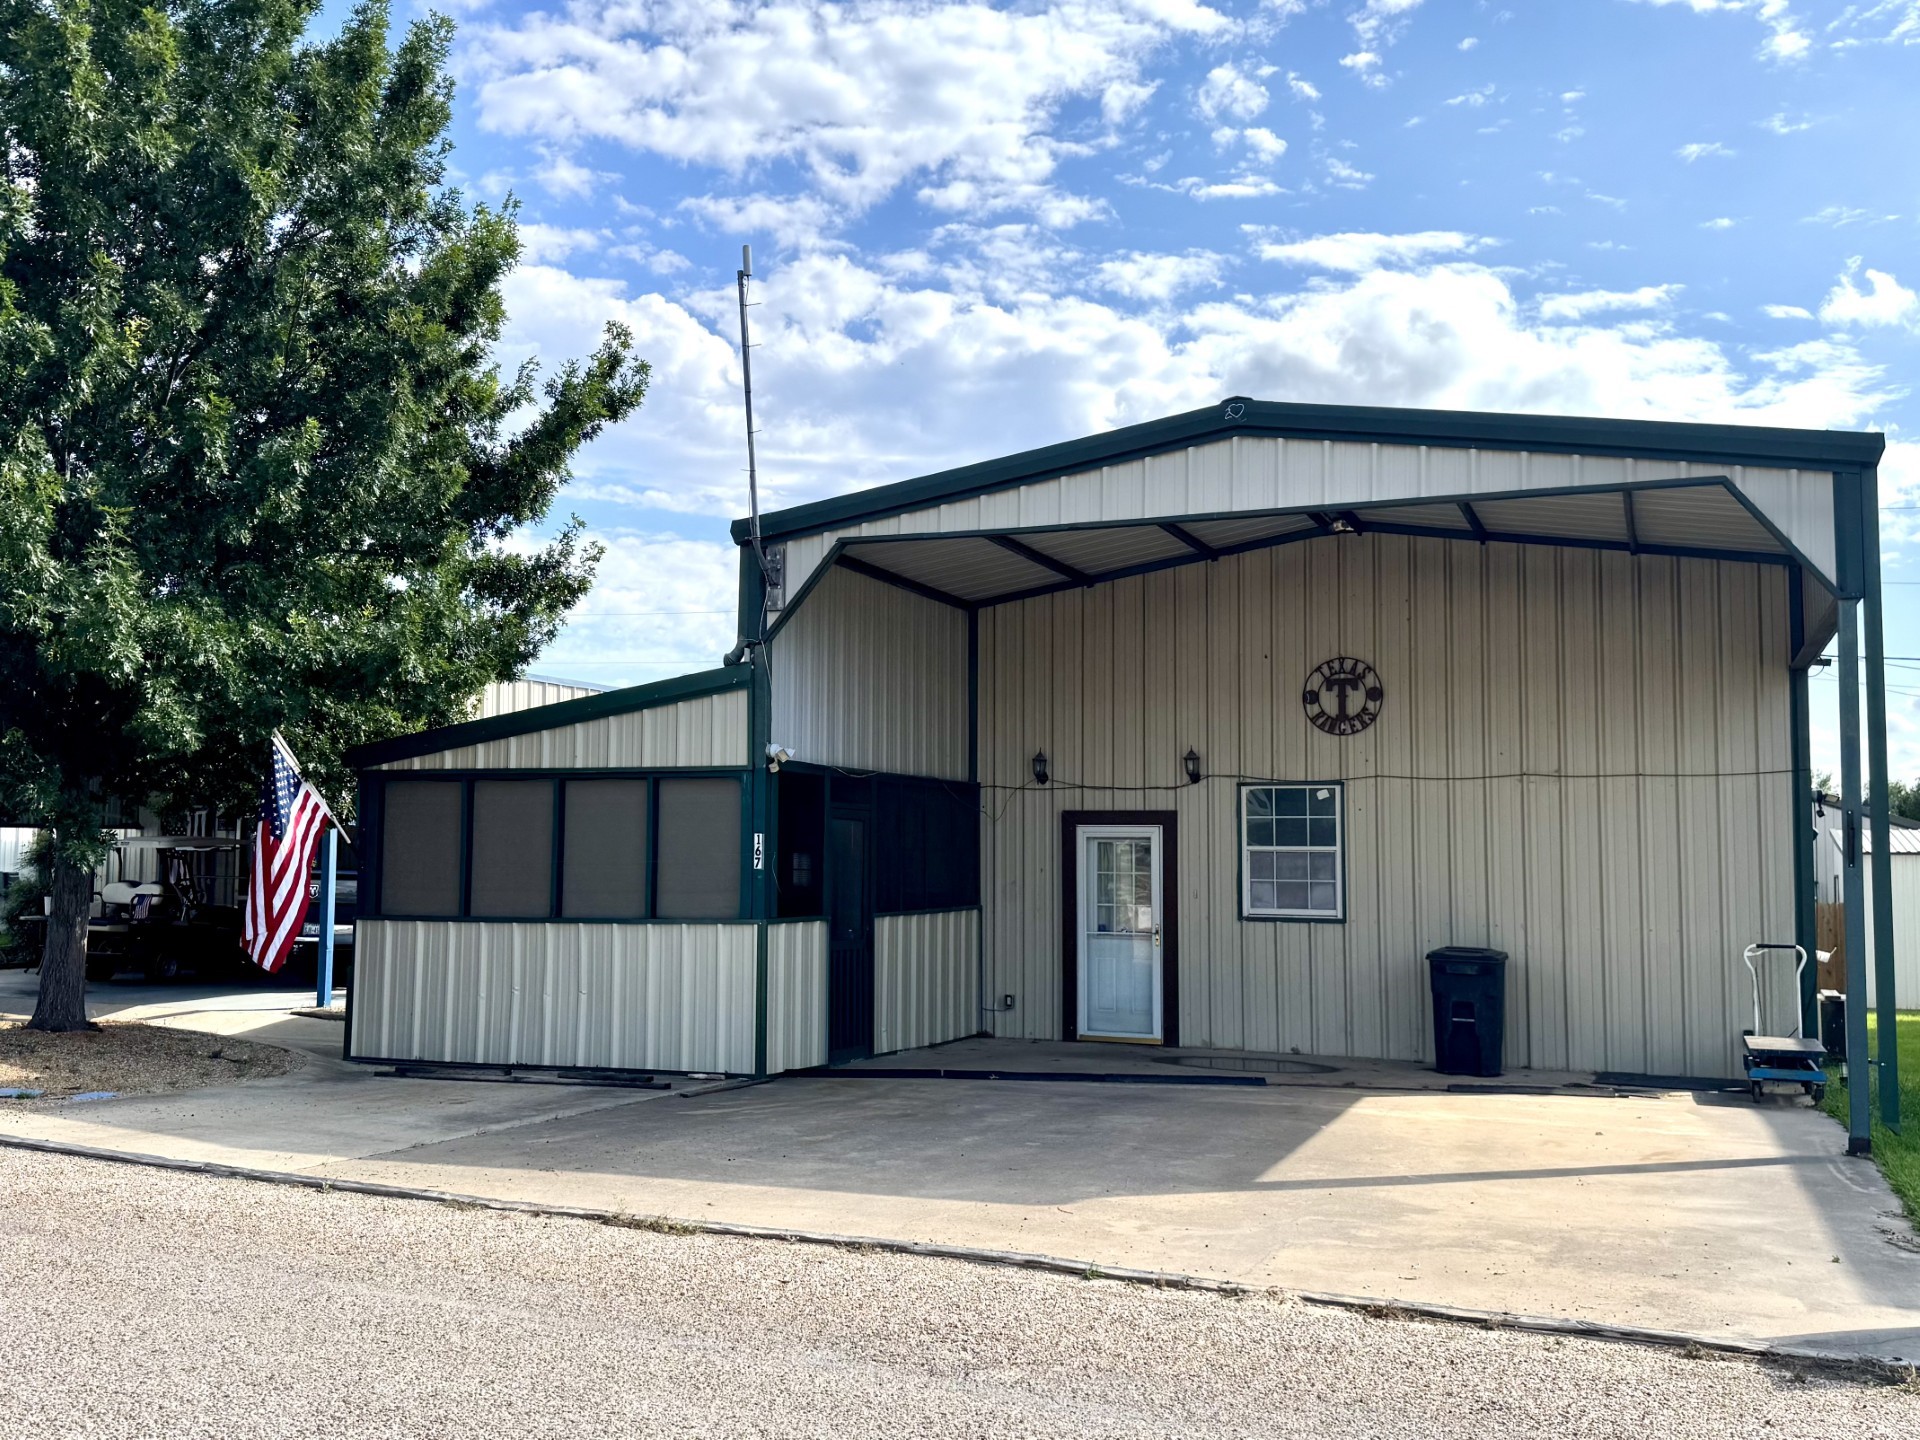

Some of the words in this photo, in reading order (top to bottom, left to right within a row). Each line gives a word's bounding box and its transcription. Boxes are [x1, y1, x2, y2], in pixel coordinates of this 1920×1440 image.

[1315, 657, 1372, 679] TEXAS
[1326, 678, 1359, 722] T
[1310, 708, 1376, 735] RANGERS
[754, 834, 762, 869] 167
